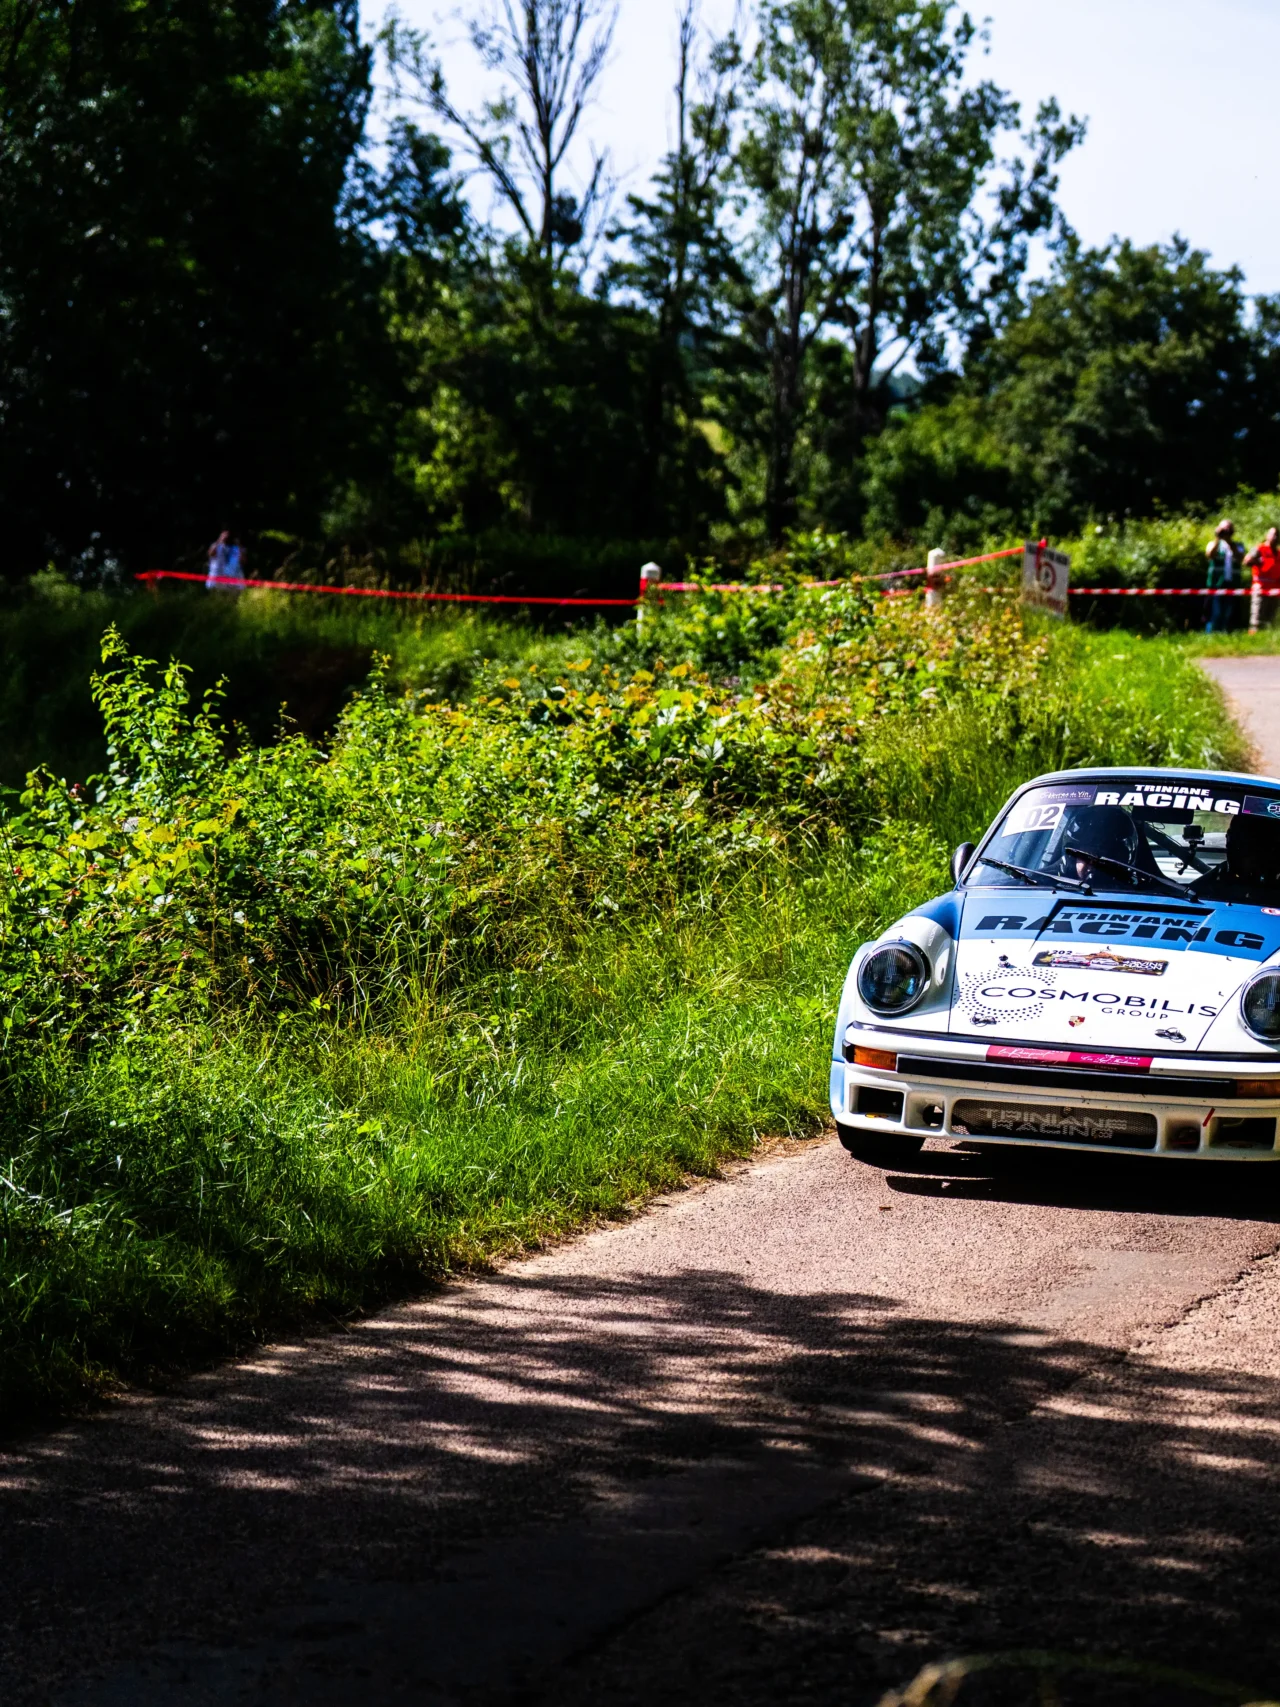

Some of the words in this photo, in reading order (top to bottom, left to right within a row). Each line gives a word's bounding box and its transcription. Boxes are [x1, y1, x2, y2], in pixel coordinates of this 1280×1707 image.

[1134, 784, 1210, 797] TRINIANE
[1093, 791, 1241, 815] RACING
[1059, 912, 1201, 929] TRINIANE
[974, 915, 1266, 951] RACING
[980, 986, 1218, 1017] COSMOBILIS
[1101, 1007, 1169, 1020] GROUP
[980, 1107, 1128, 1130] TRINIANE
[991, 1119, 1115, 1139] RACING
